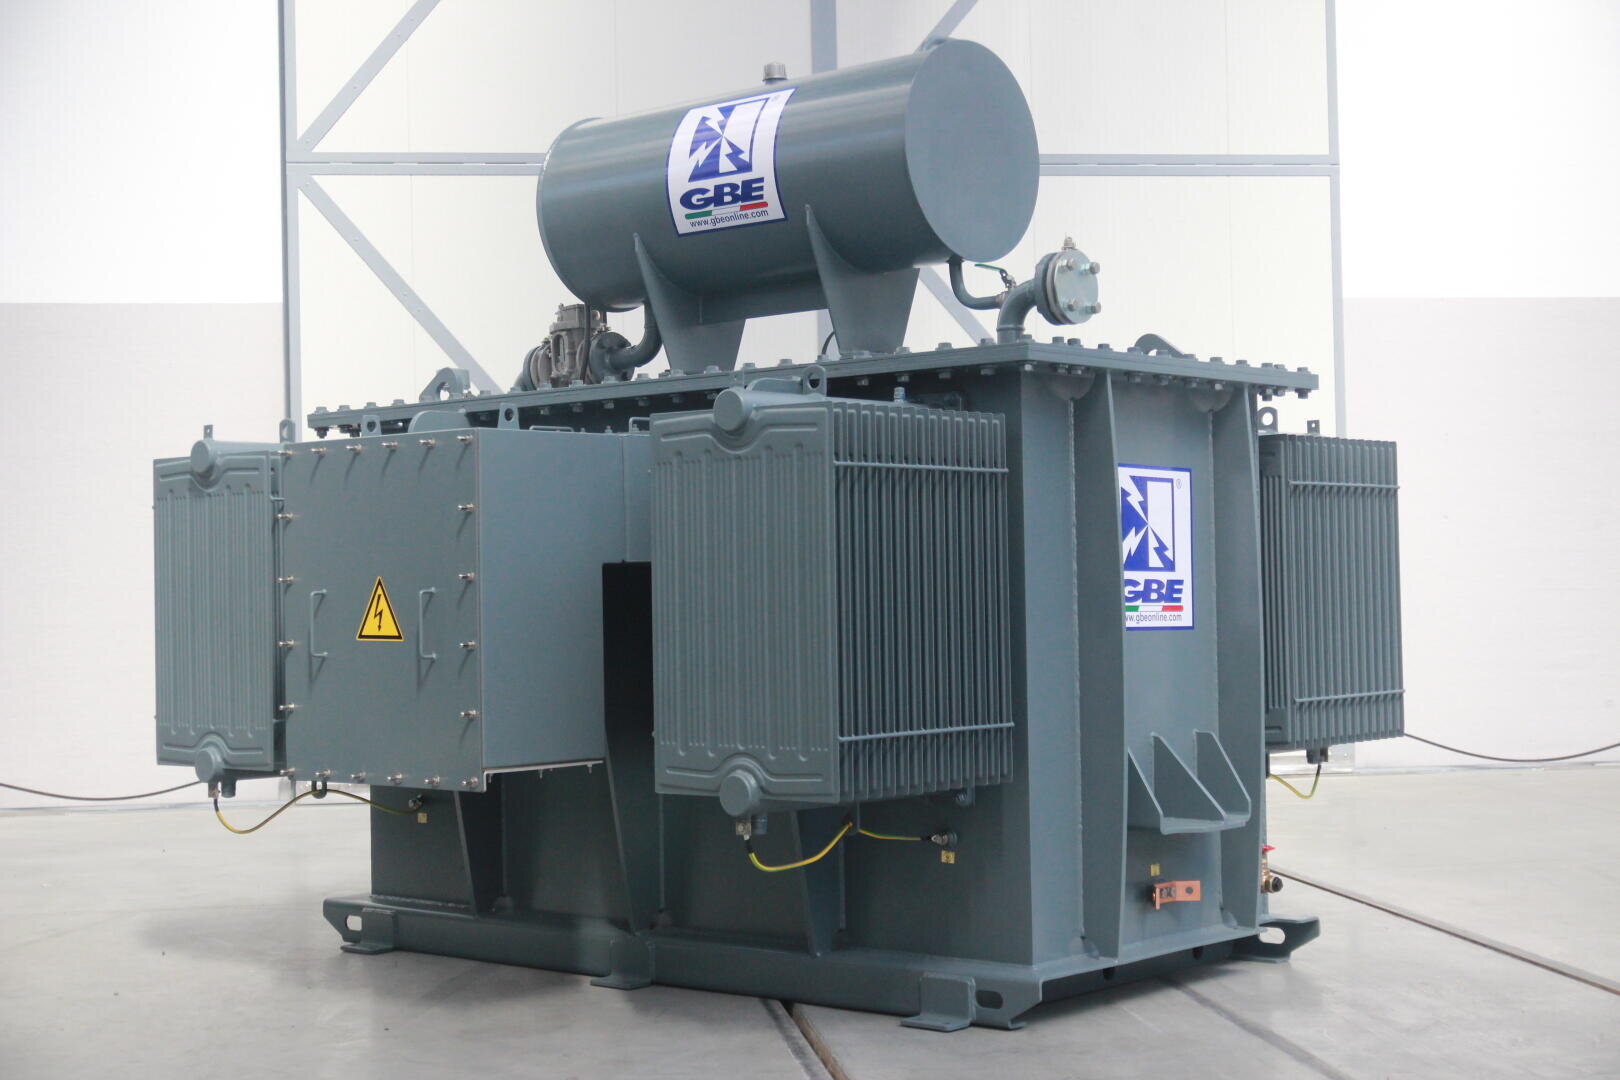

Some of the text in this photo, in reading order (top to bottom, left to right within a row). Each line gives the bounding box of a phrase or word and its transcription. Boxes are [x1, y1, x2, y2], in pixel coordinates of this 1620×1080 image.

[680, 177, 764, 210] GBE
[690, 209, 769, 227] www.gbeonline.com
[1124, 579, 1184, 603] GBE
